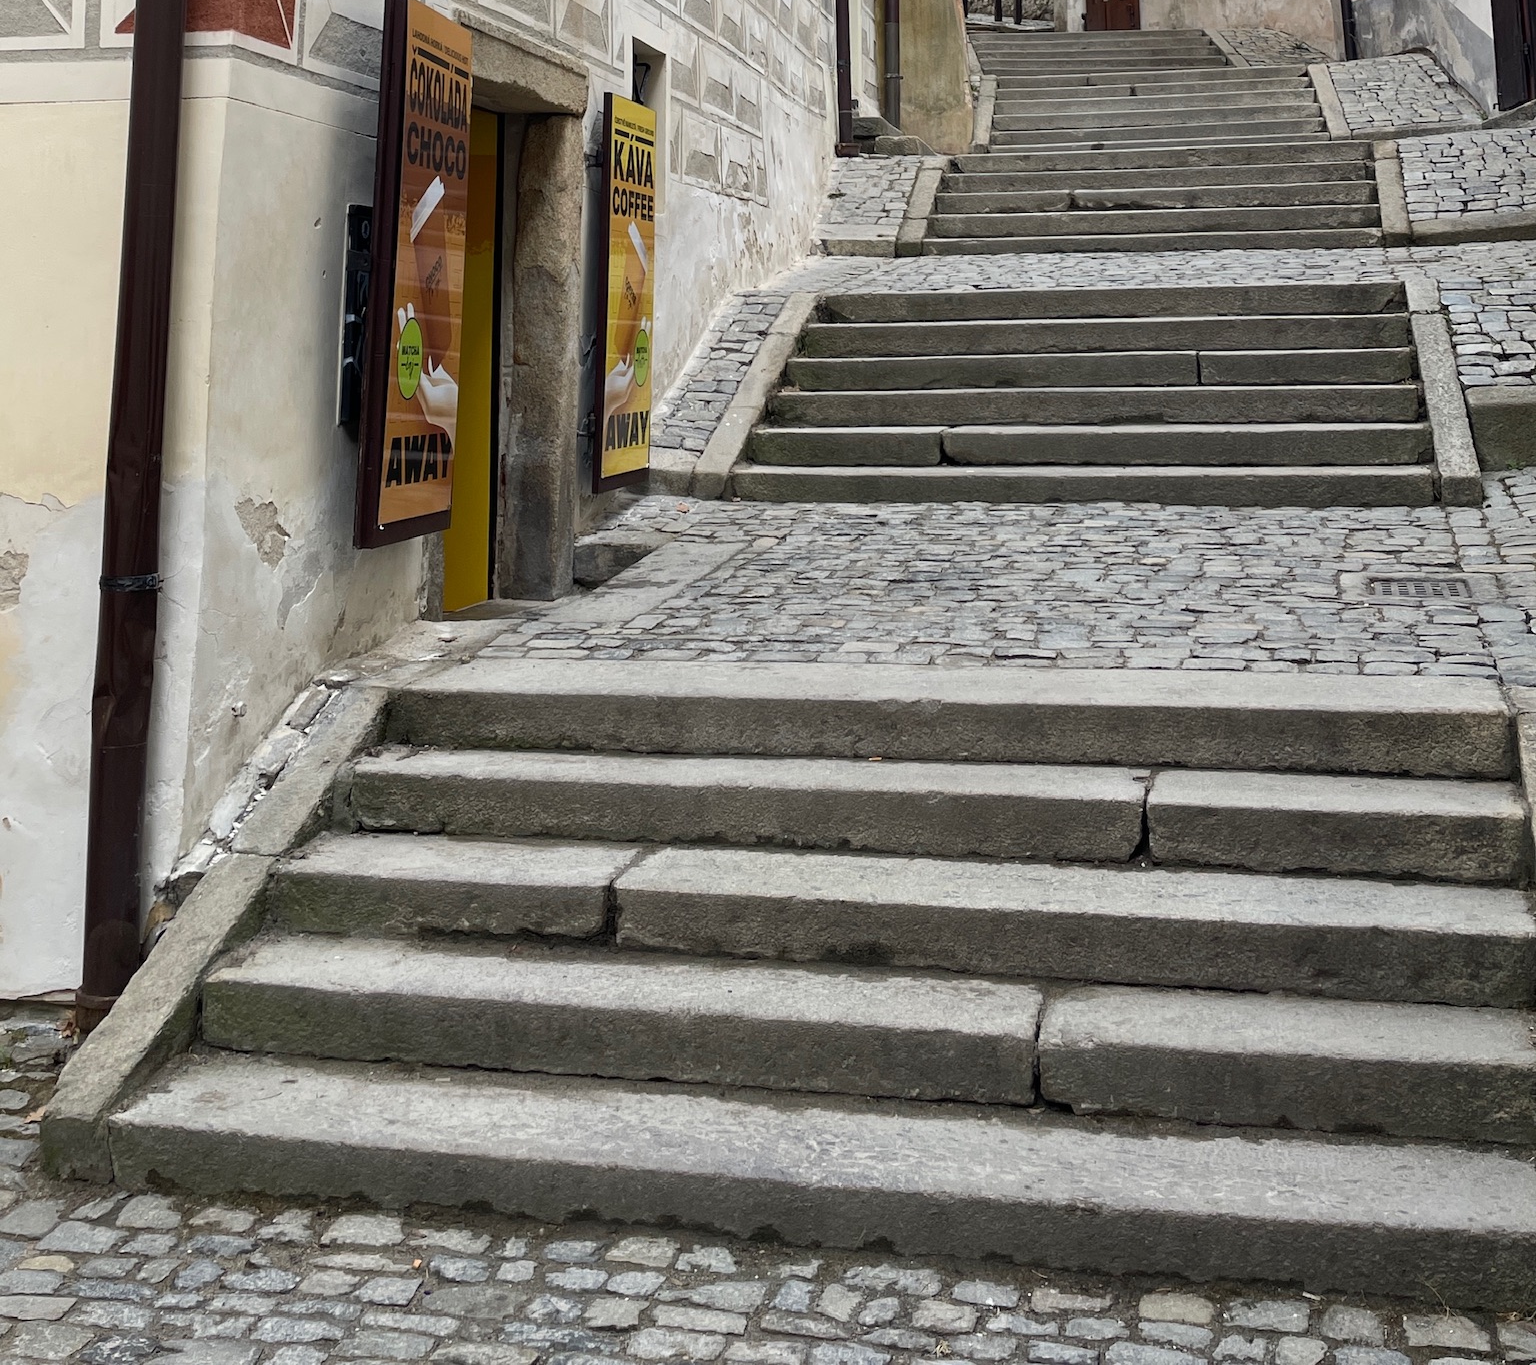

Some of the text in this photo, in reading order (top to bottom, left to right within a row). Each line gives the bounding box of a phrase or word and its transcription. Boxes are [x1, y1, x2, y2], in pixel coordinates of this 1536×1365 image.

[409, 43, 468, 133] ČOKOLÁDA
[406, 121, 467, 181] CHOCO
[613, 133, 654, 189] KÁVA
[612, 185, 654, 222] COFFEE
[401, 345, 420, 356] MATCHA
[604, 410, 650, 452] AWAY
[384, 432, 454, 489] AWAY
